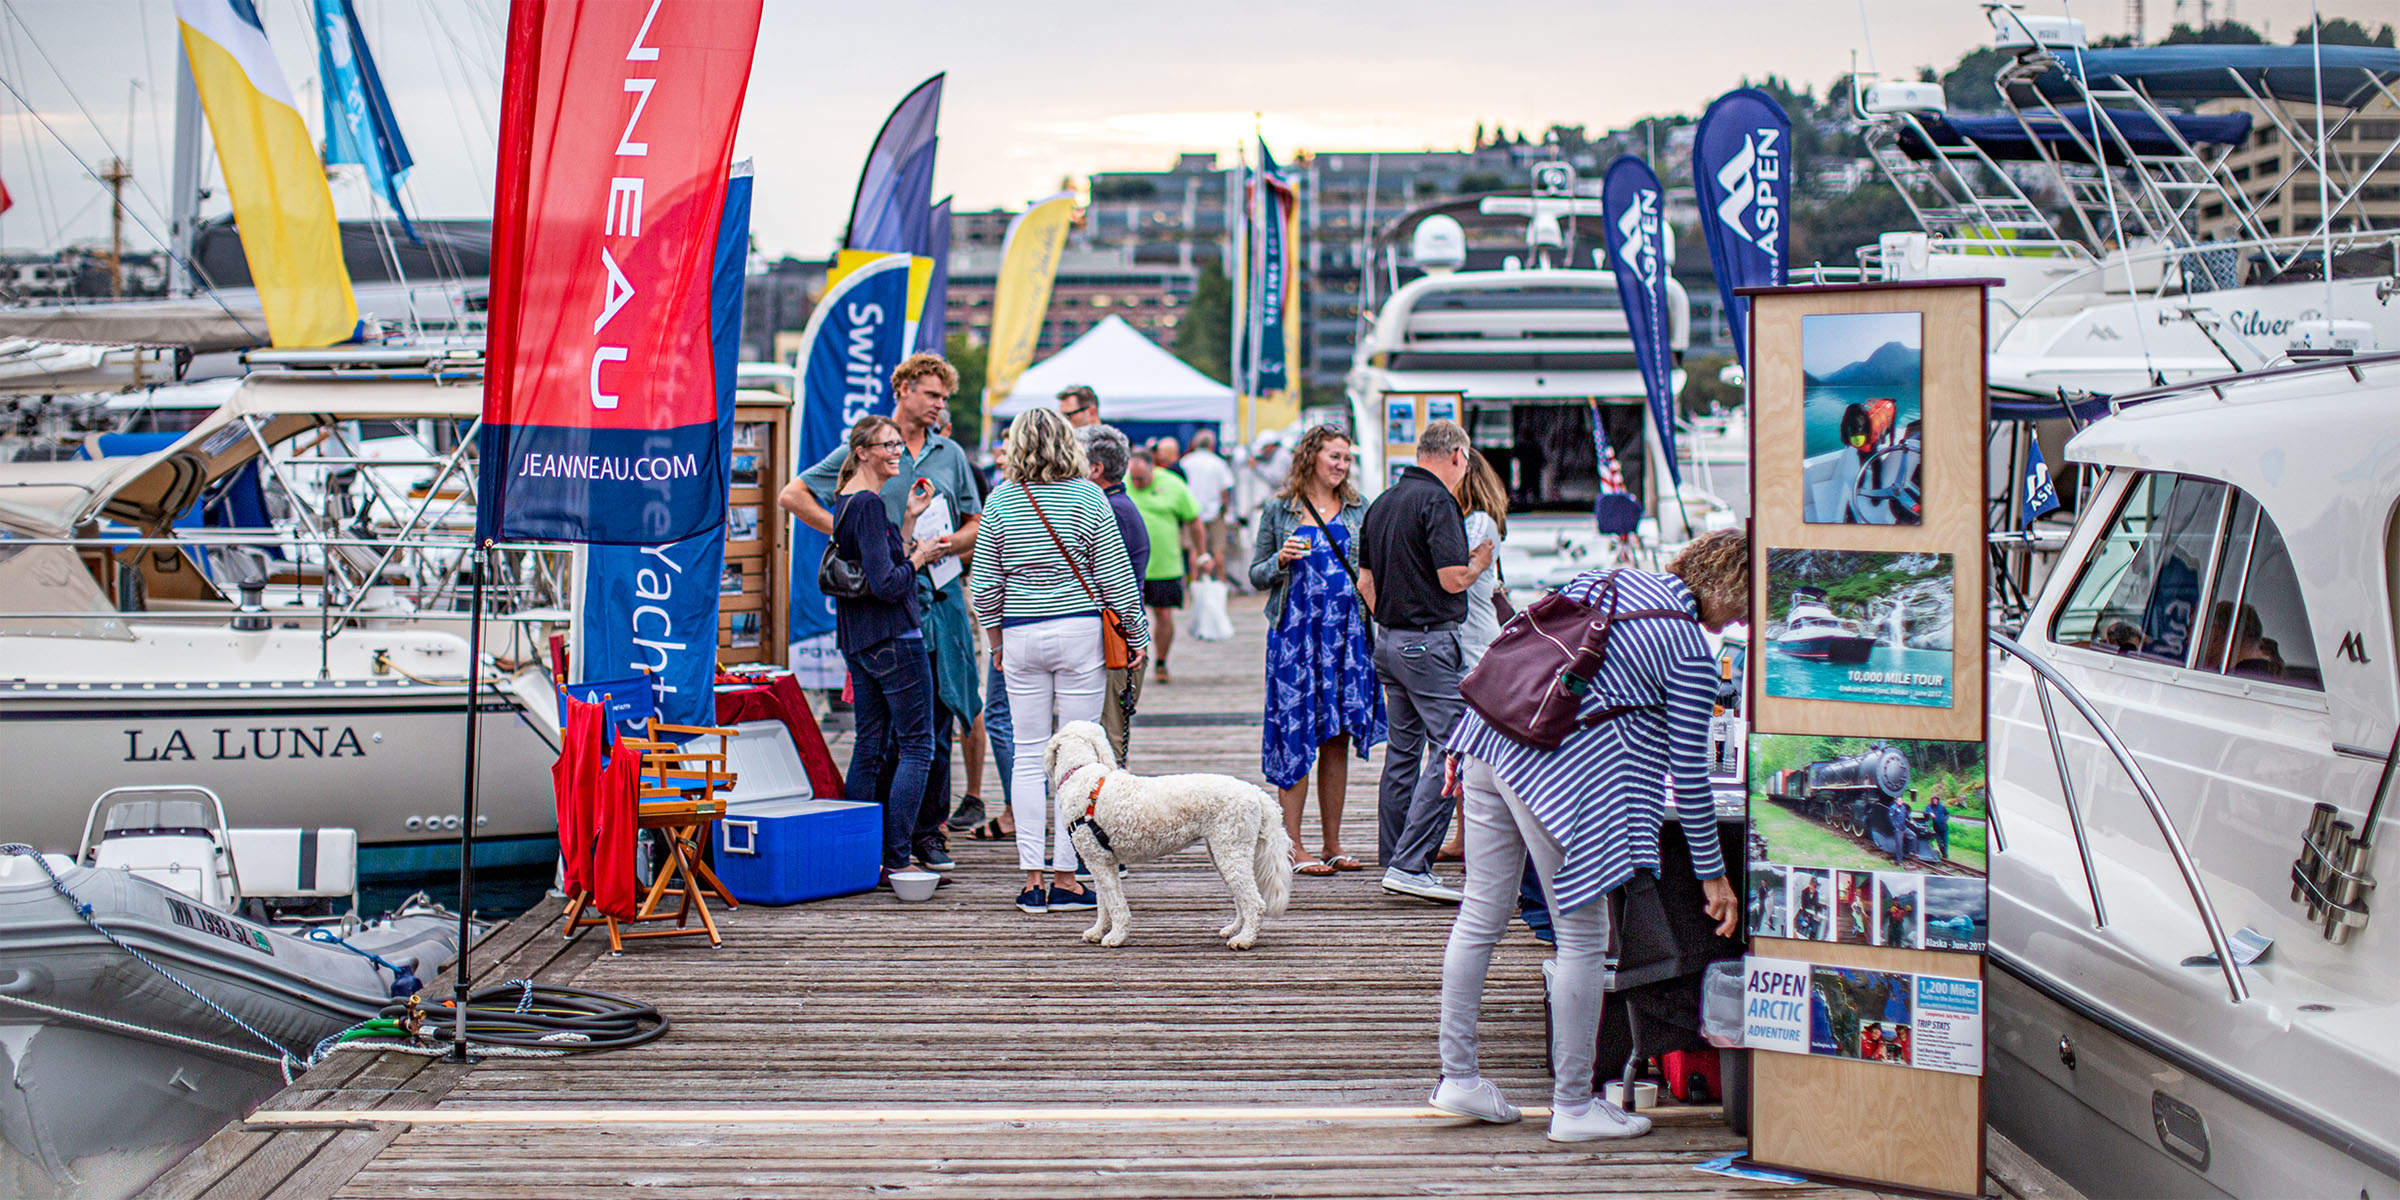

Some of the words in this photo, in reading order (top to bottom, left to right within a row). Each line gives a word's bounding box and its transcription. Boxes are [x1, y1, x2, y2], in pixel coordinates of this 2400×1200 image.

[1755, 127, 1780, 258] ASPEN
[1640, 188, 1658, 297] ASPEN
[2230, 309, 2295, 337] Silver
[518, 452, 698, 482] JEANNEAU.COM
[1847, 670, 1884, 684] 10,000
[1884, 672, 1912, 685] MILE
[1912, 674, 1945, 687] TOUR
[123, 729, 197, 762] LA
[211, 726, 367, 760] LUNA
[1926, 938, 1948, 948] Alaska
[1952, 940, 1968, 950] June
[1968, 942, 1987, 952] 2017
[1747, 970, 1806, 998] ASPEN
[1920, 981, 1948, 995] 1,200
[1950, 983, 1977, 998] Miles
[1747, 998, 1804, 1022] ARCTIC
[1747, 1024, 1801, 1042] ADVENTURE
[1917, 1019, 1932, 1028] TRIP
[1932, 1021, 1951, 1031] STATS
